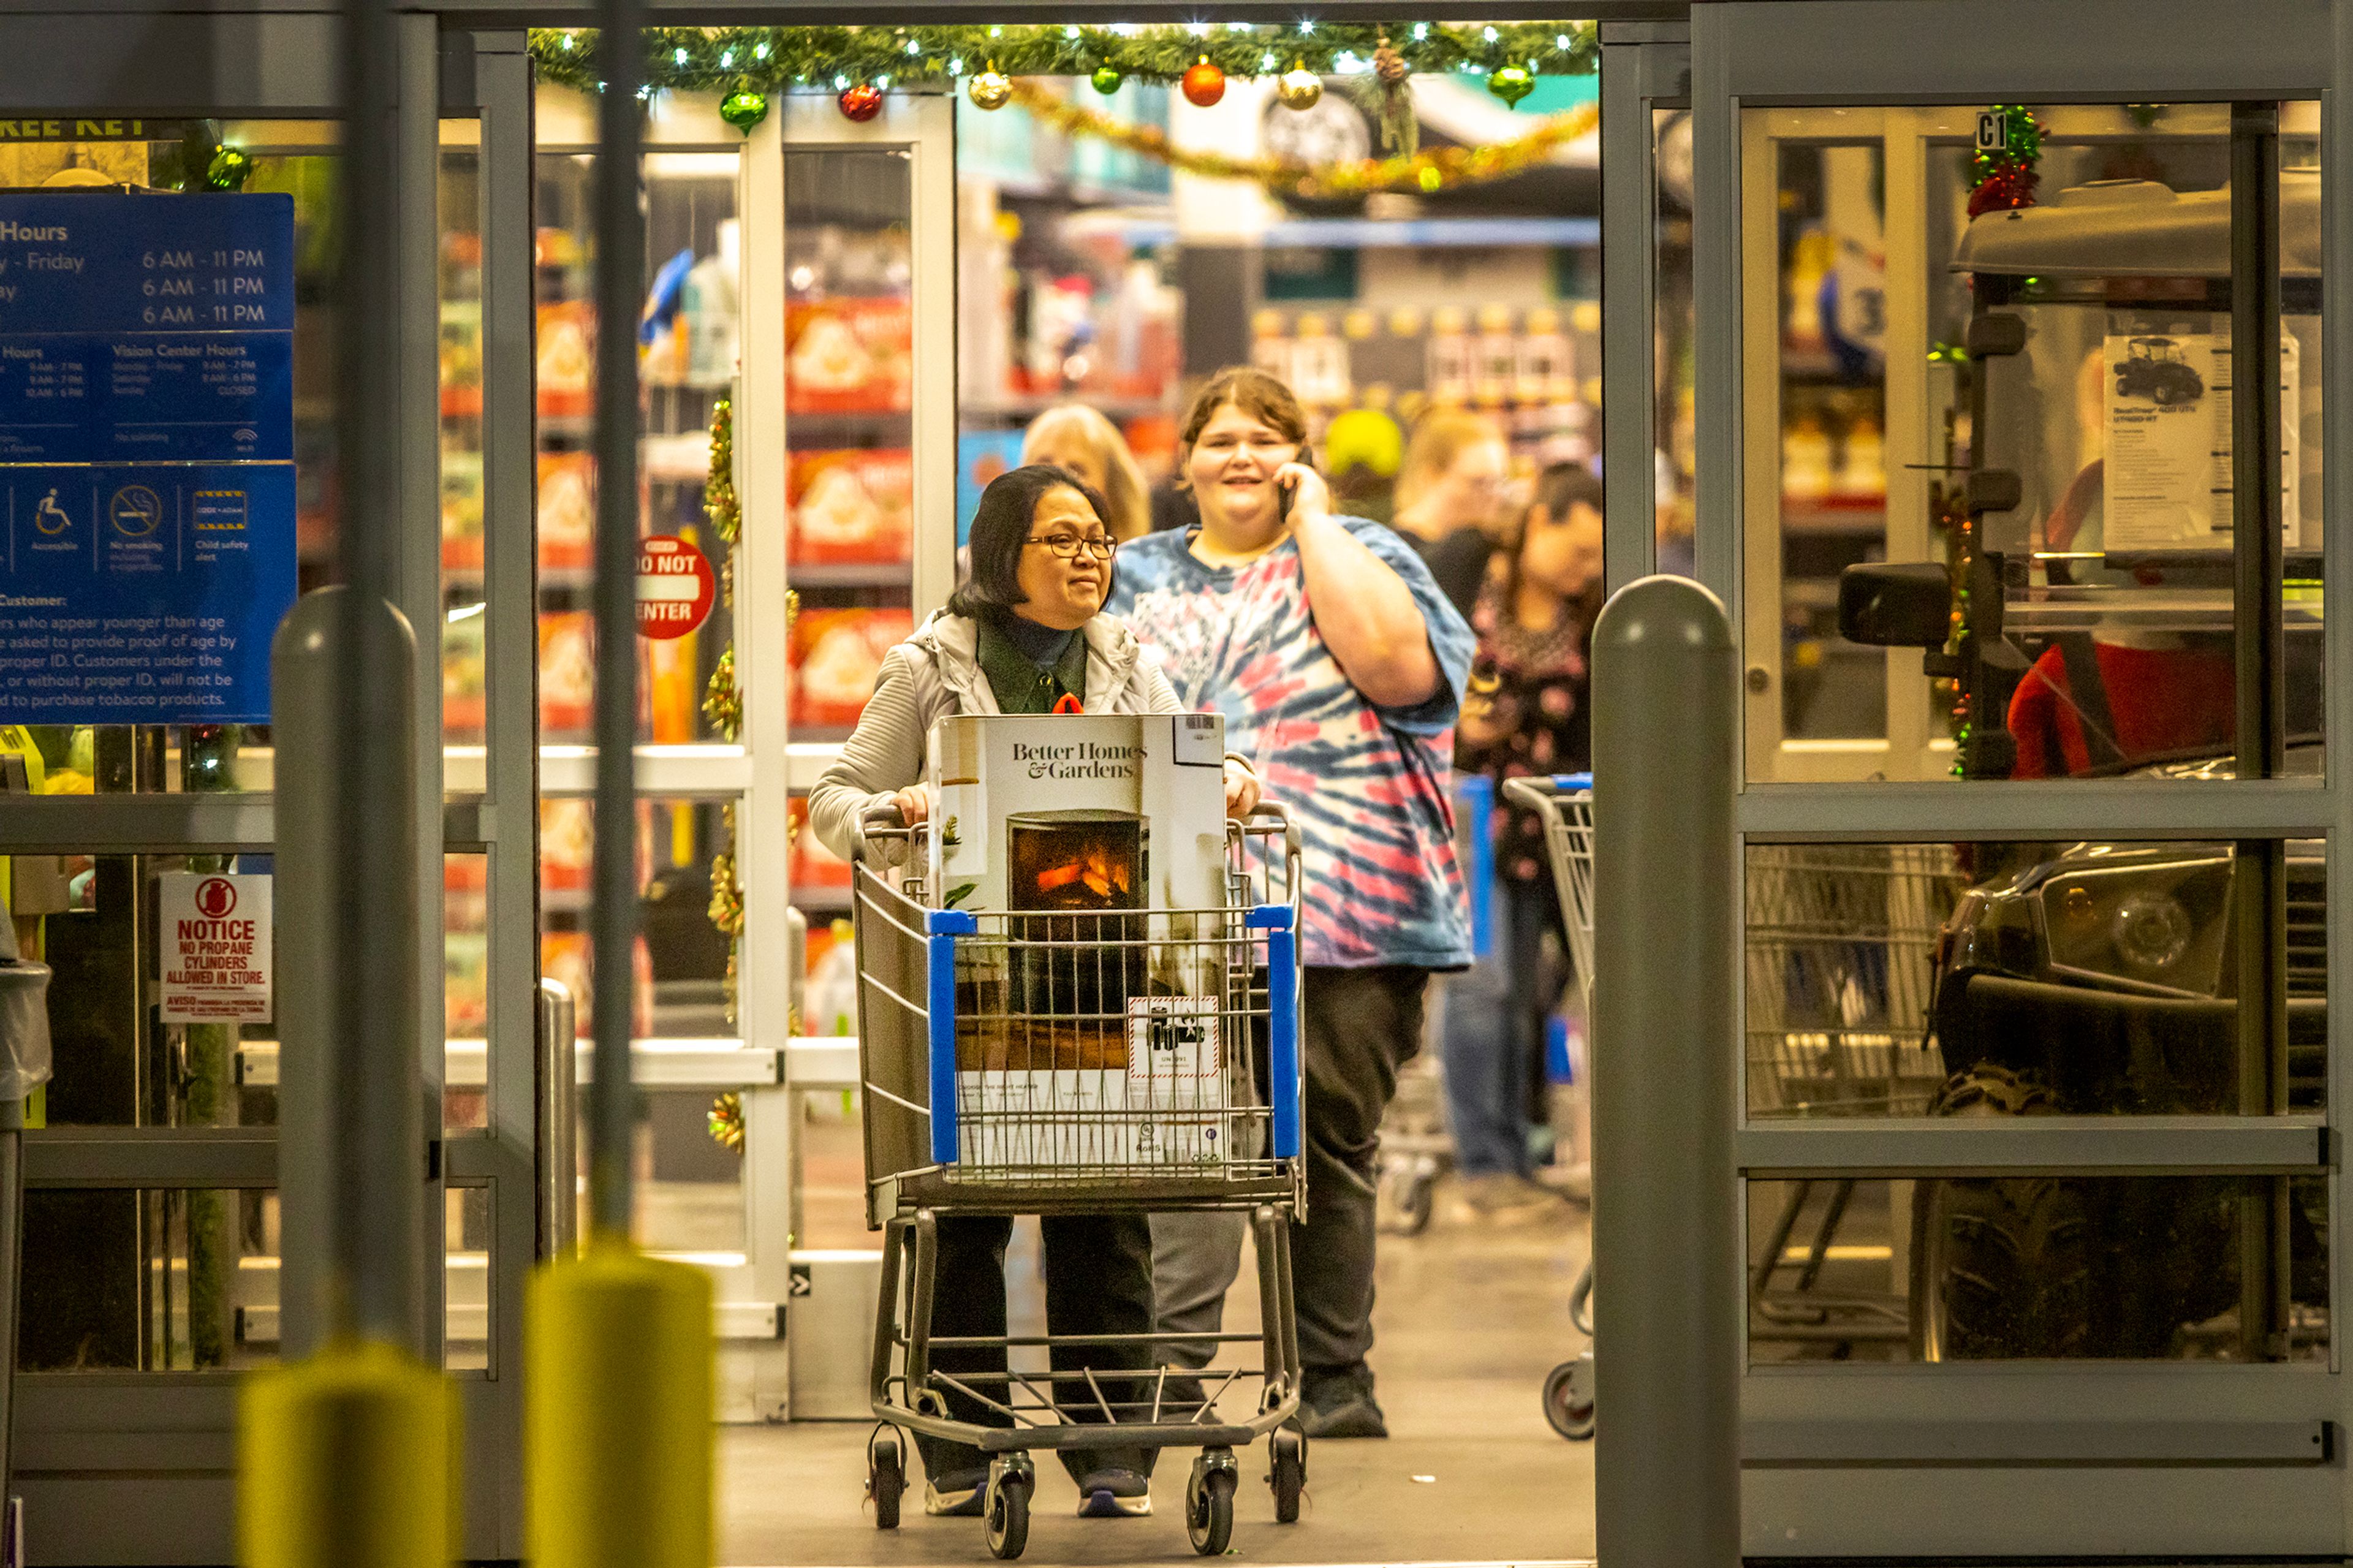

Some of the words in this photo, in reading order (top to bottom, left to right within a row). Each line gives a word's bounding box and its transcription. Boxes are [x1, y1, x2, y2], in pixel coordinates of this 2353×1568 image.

[1979, 114, 2005, 147] C1
[0, 221, 67, 241] Hours
[28, 251, 85, 275] Friday
[142, 250, 155, 268] 6
[159, 250, 195, 268] AM
[214, 249, 227, 267] 11
[233, 249, 265, 267] PM
[142, 278, 155, 297] 6
[159, 278, 195, 295] AM
[214, 277, 227, 295] 11
[233, 276, 264, 295] PM
[142, 306, 156, 324] 6
[159, 305, 195, 323] AM
[214, 305, 227, 322] 11
[233, 304, 265, 322] PM
[2, 345, 43, 359] Hours
[112, 344, 153, 357] Vision
[156, 344, 202, 357] Center
[206, 344, 246, 356] Hours
[218, 385, 256, 395] CLOSED
[657, 554, 698, 574] NOT
[17, 616, 48, 629] who
[51, 618, 99, 632] appear
[103, 618, 161, 632] younger
[164, 615, 195, 628] than
[199, 618, 225, 631] age
[9, 635, 50, 648] asked
[53, 636, 69, 648] to
[71, 635, 126, 651] provide
[127, 634, 169, 651] proof
[171, 634, 189, 648] of
[191, 637, 216, 651] age
[219, 634, 237, 651] by
[73, 653, 151, 667] Customers
[154, 653, 196, 667] under
[199, 653, 222, 667] the
[7, 676, 23, 687] or
[26, 674, 81, 687] without
[84, 676, 133, 691] proper
[160, 673, 183, 686] will
[186, 675, 212, 686] not
[215, 673, 233, 686] be
[12, 695, 28, 706] to
[31, 693, 95, 710] purchase
[98, 692, 156, 706] tobacco
[159, 692, 225, 708] products.
[1013, 743, 1074, 761] Better
[1078, 742, 1148, 760] Homes
[177, 920, 256, 941] NOTICE
[179, 941, 195, 955] NO
[199, 941, 253, 955] PROPANE
[184, 956, 248, 969] CYLINDERS
[166, 971, 214, 984] ALLOWED
[217, 971, 227, 984] IN
[230, 971, 265, 984] STORE.
[167, 996, 196, 1006] AVISO
